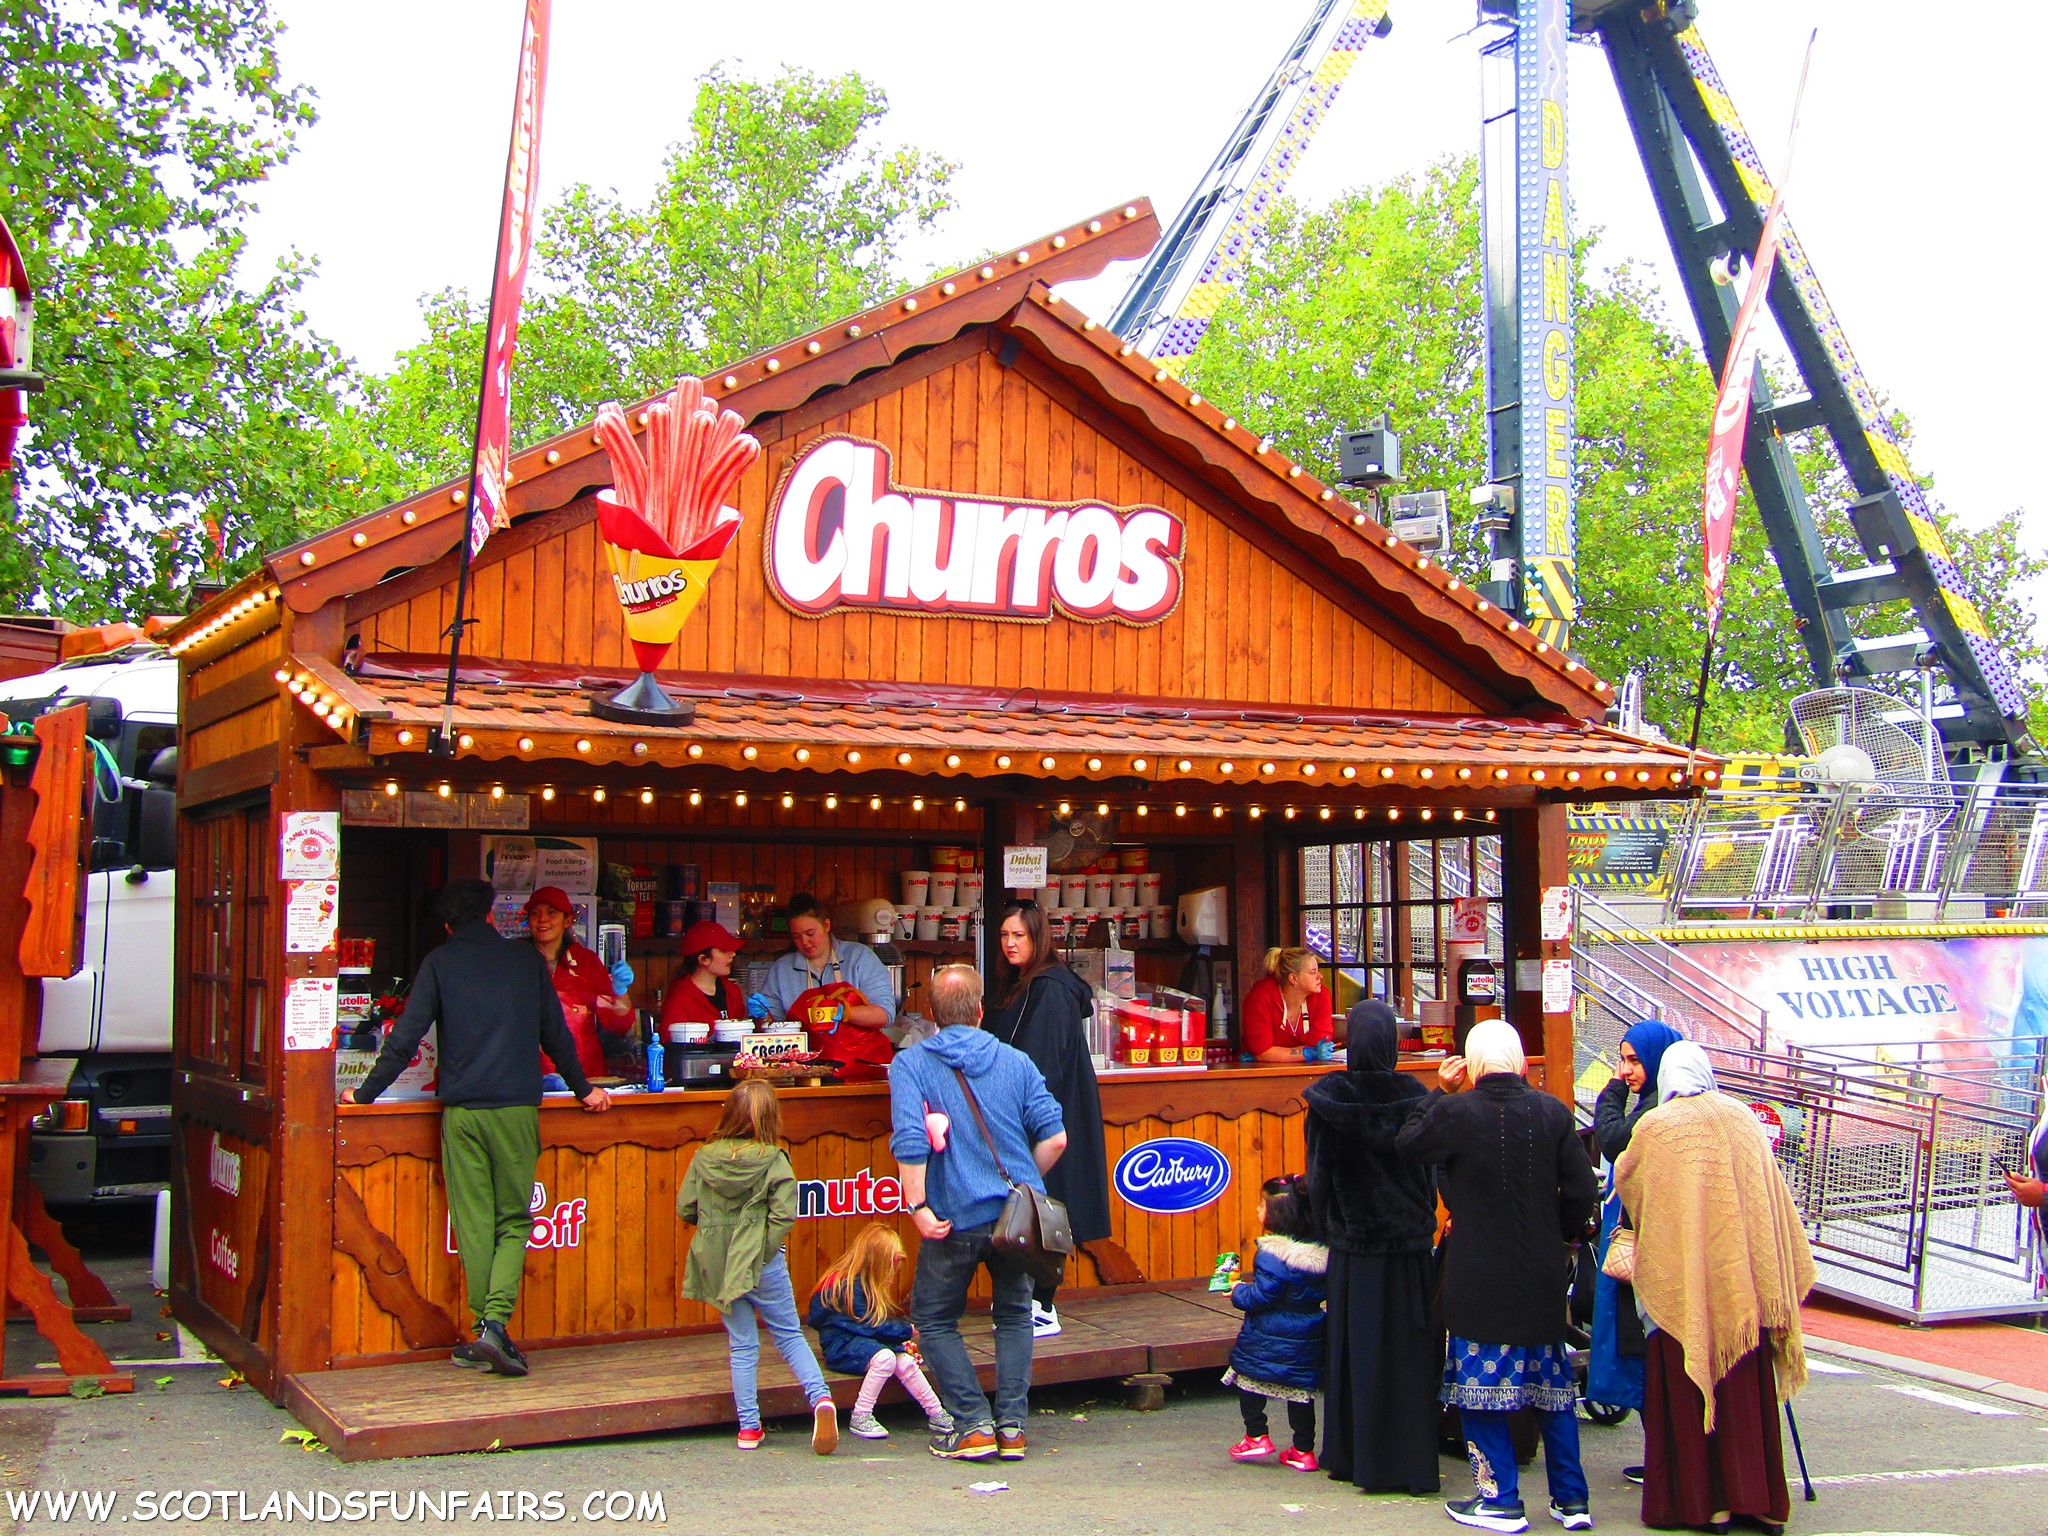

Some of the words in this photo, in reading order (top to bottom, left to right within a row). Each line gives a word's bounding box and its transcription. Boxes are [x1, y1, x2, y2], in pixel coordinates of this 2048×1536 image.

[1541, 99, 1570, 557] DANGER
[775, 438, 1178, 614] Churros
[1568, 833, 1608, 848] TMOS
[563, 858, 587, 866] Allergy
[1010, 853, 1042, 865] Dubai
[1568, 849, 1602, 870] EAR
[544, 869, 587, 877] Intolerance?
[1009, 866, 1034, 874] topping
[626, 879, 658, 891] YORKSHIR
[639, 891, 650, 902] TEA
[1799, 955, 1898, 981] HIGH
[1467, 975, 1494, 984] nutella
[339, 996, 370, 1005] utella
[1777, 984, 1959, 1019] VOLTAGE
[1122, 1149, 1214, 1192] Cadbury
[211, 1228, 239, 1280] Coffee
